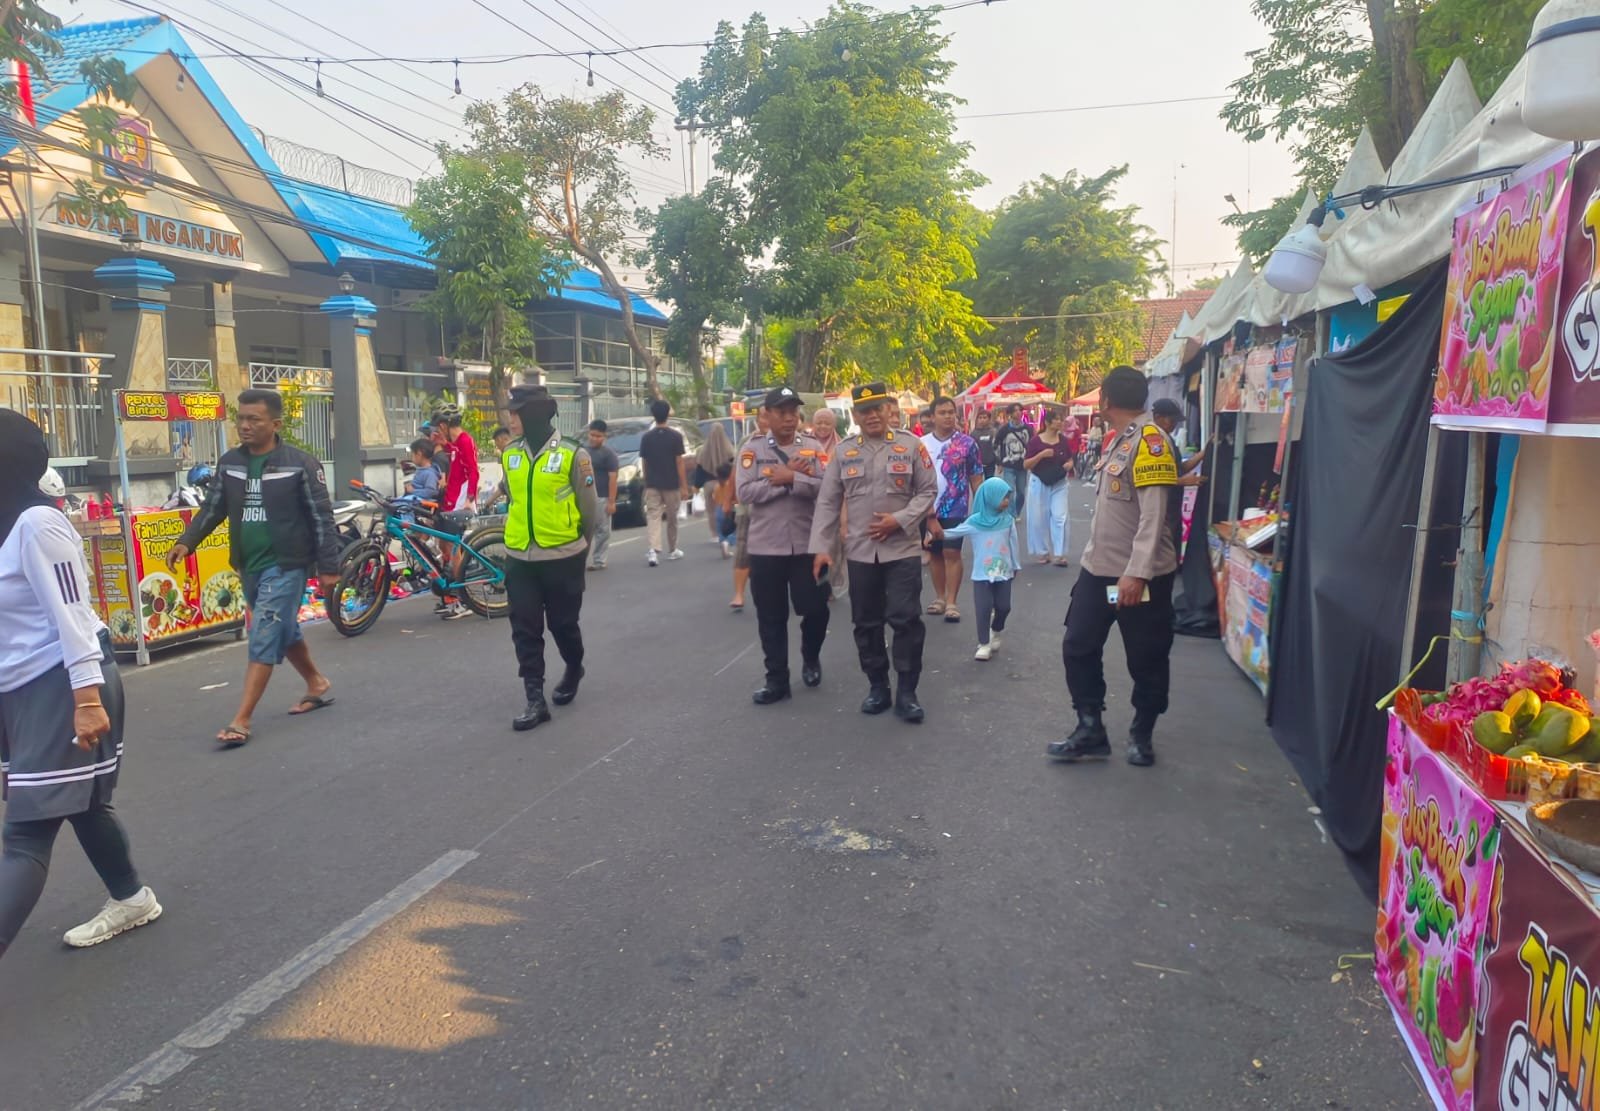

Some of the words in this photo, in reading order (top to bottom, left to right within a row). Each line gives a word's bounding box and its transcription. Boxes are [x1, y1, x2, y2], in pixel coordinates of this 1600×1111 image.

[145, 216, 242, 258] NGANJUK
[1464, 230, 1495, 302] Jus
[1495, 192, 1543, 279] Buah
[1465, 271, 1526, 351] Segar
[128, 405, 167, 418] Bintang
[187, 406, 216, 419] Topping
[887, 455, 912, 463] POLRI
[135, 522, 158, 539] Tahu
[159, 518, 185, 536] Bakso
[144, 538, 178, 558] Toppin
[1402, 782, 1428, 851] Jus
[1426, 797, 1467, 923] Buah
[1405, 847, 1456, 945] Segar
